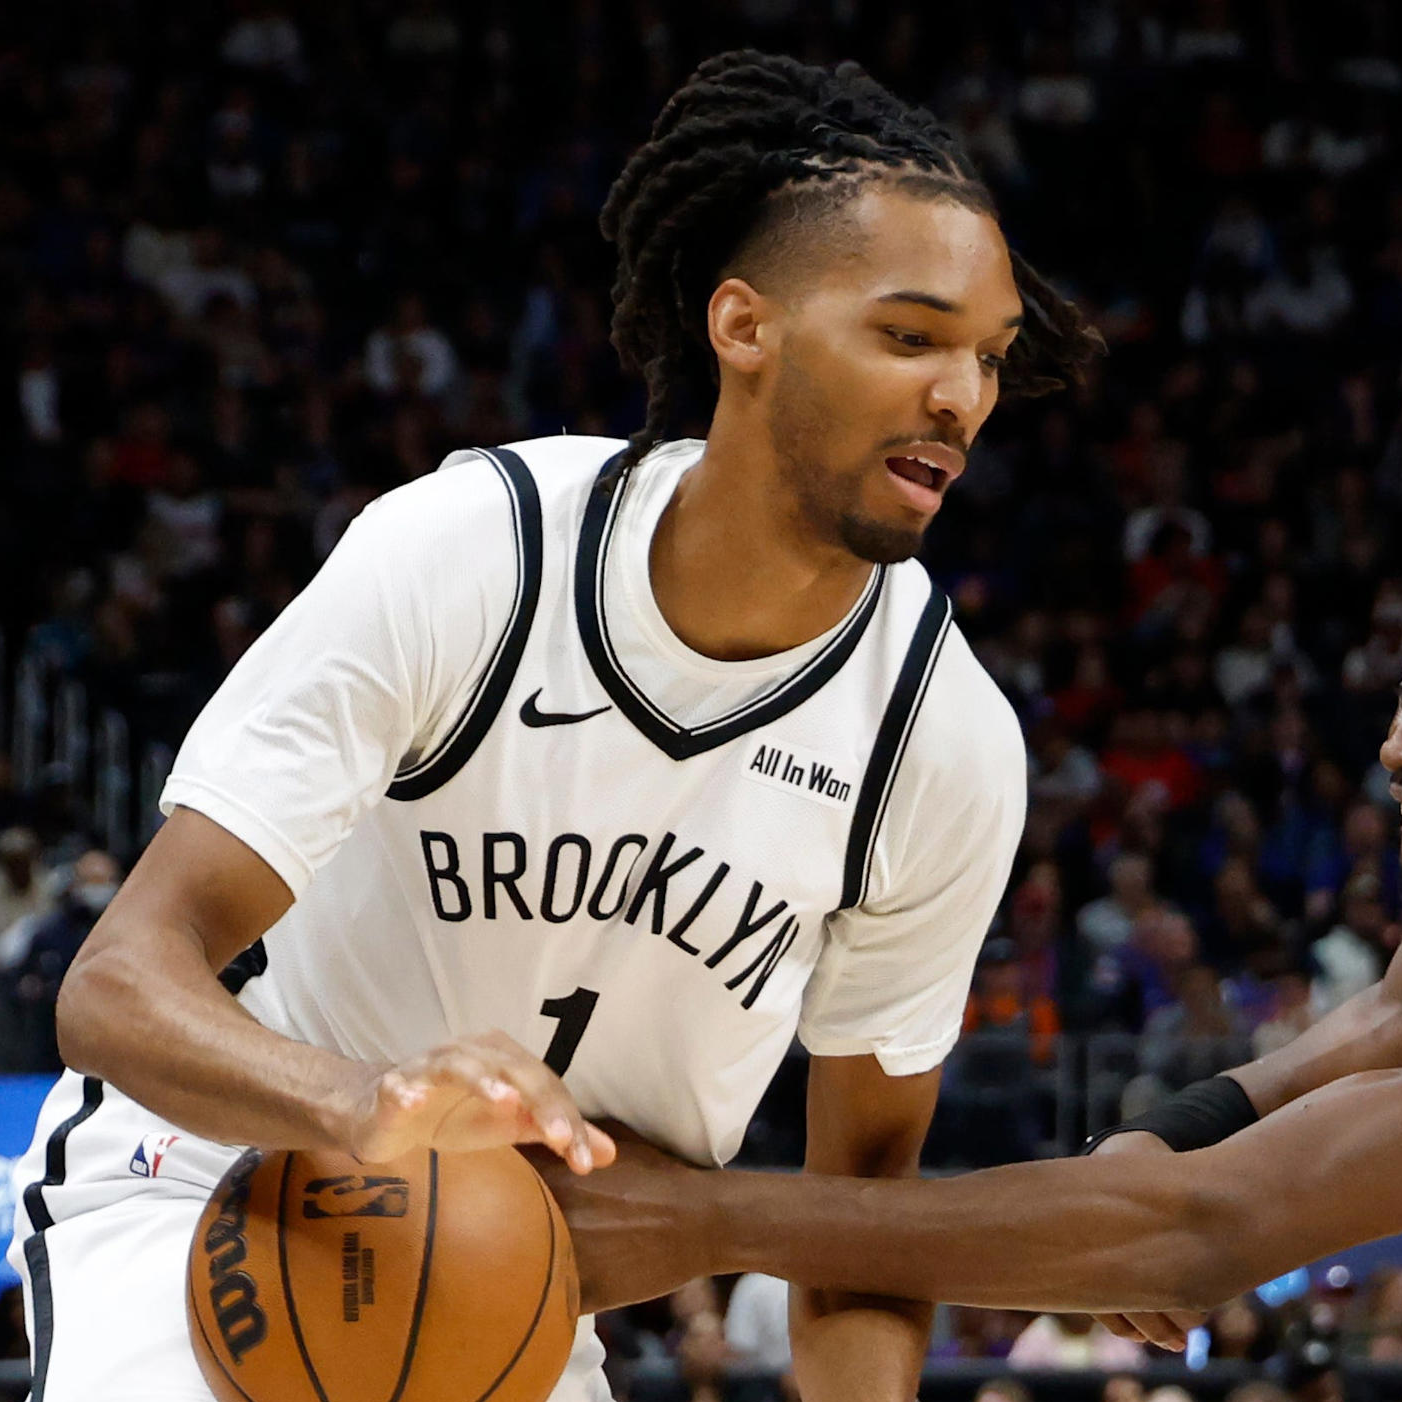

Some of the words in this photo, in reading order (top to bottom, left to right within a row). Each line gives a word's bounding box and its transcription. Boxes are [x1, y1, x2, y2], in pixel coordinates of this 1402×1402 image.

[750, 744, 782, 778] All
[781, 753, 805, 787] In
[808, 761, 852, 803] Won
[420, 830, 800, 1011] BROOKLYN
[539, 986, 601, 1079] 1
